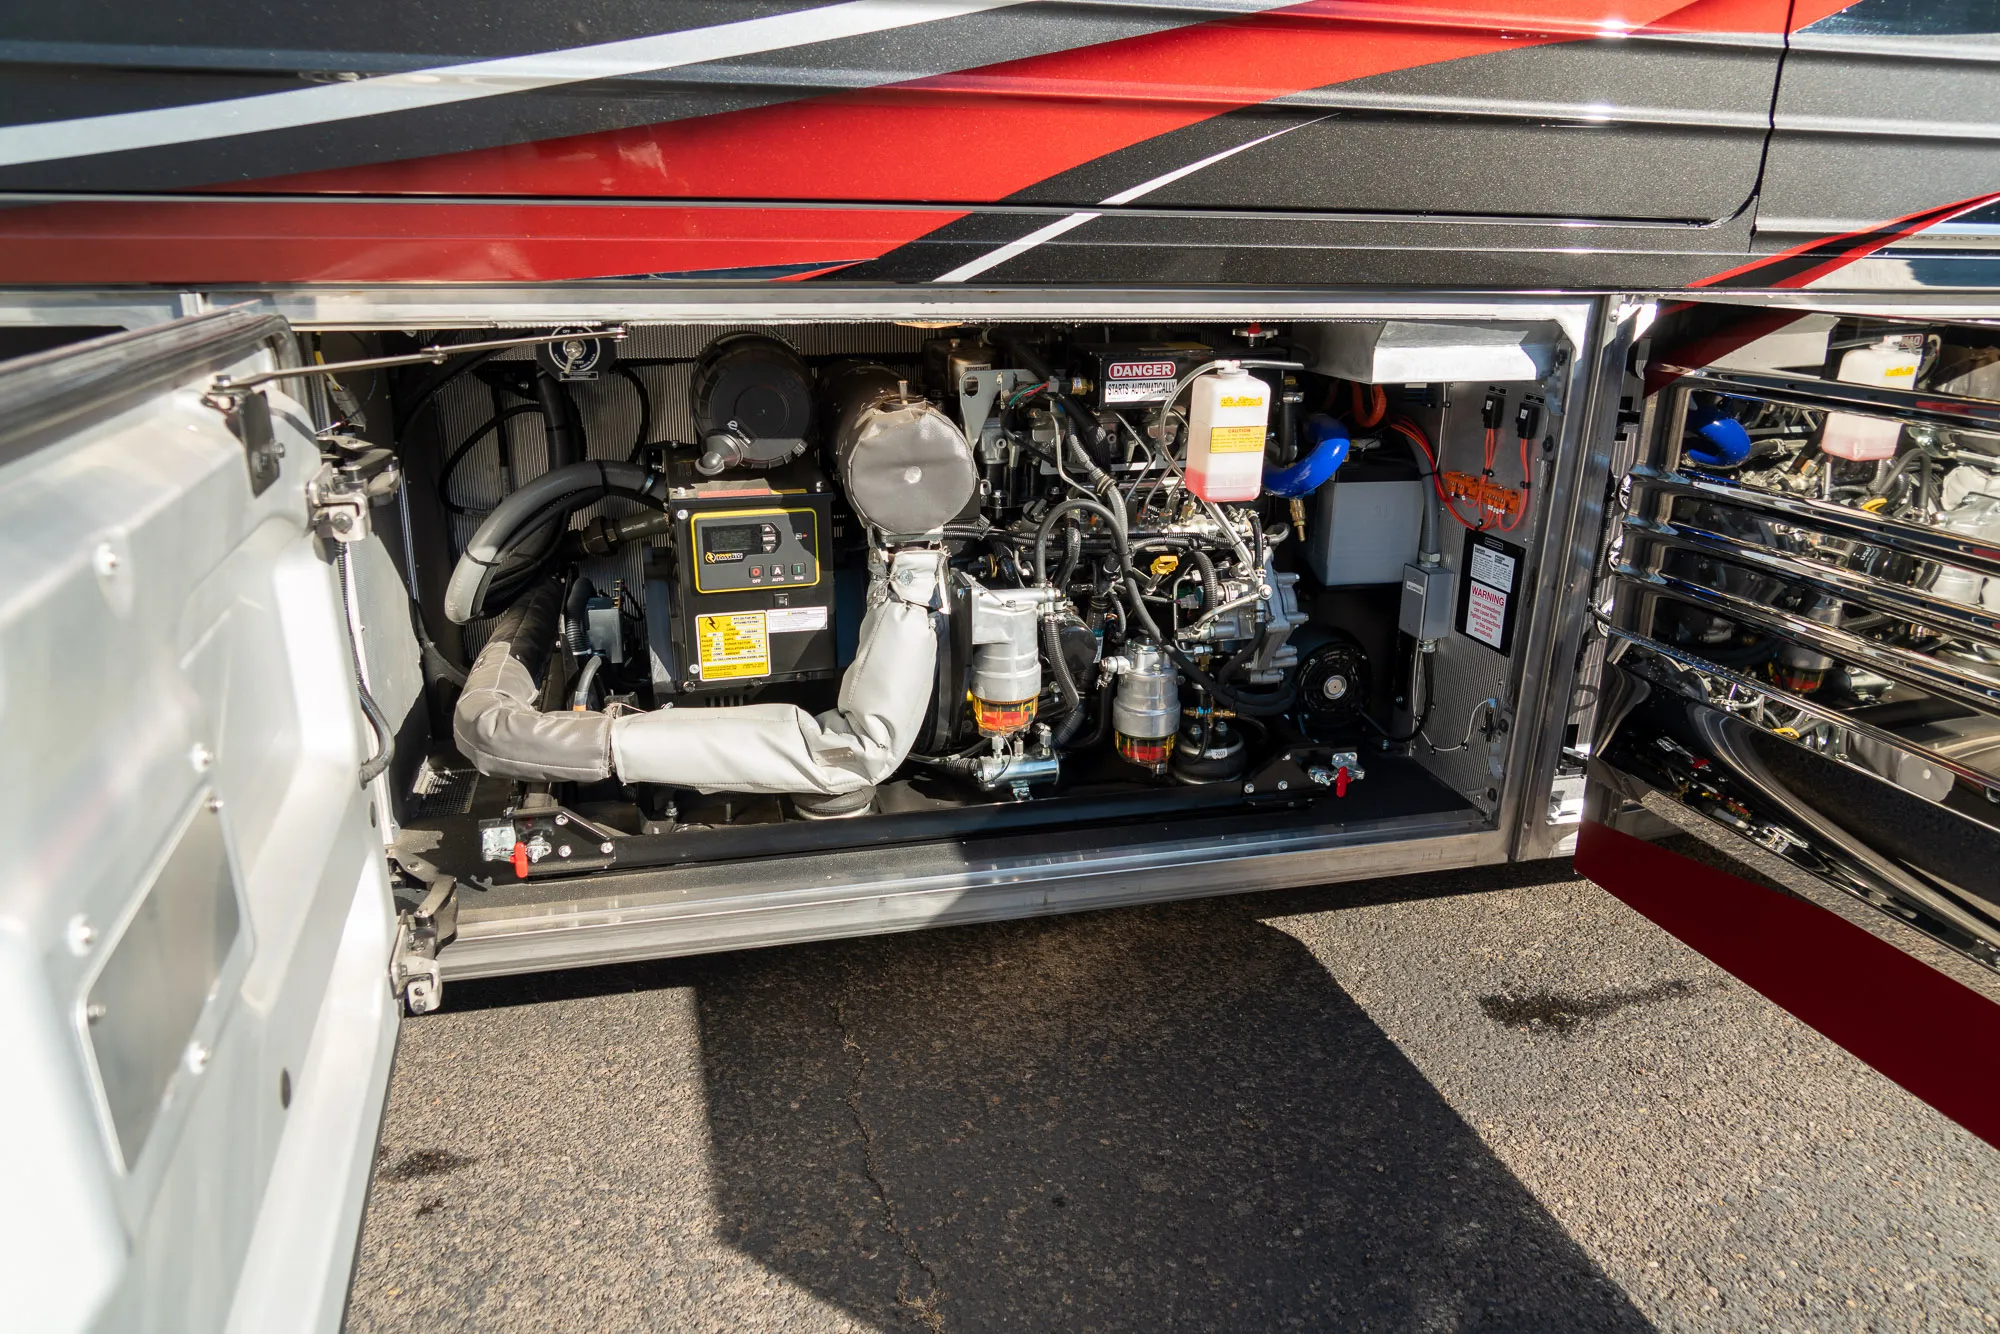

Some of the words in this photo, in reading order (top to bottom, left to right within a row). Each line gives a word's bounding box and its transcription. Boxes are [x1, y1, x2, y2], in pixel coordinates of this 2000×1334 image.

[1113, 364, 1172, 377] DANGER
[1108, 383, 1129, 395] STARTS
[1132, 381, 1176, 395] AUTOMATICALLY
[1472, 585, 1504, 606] WARNING
